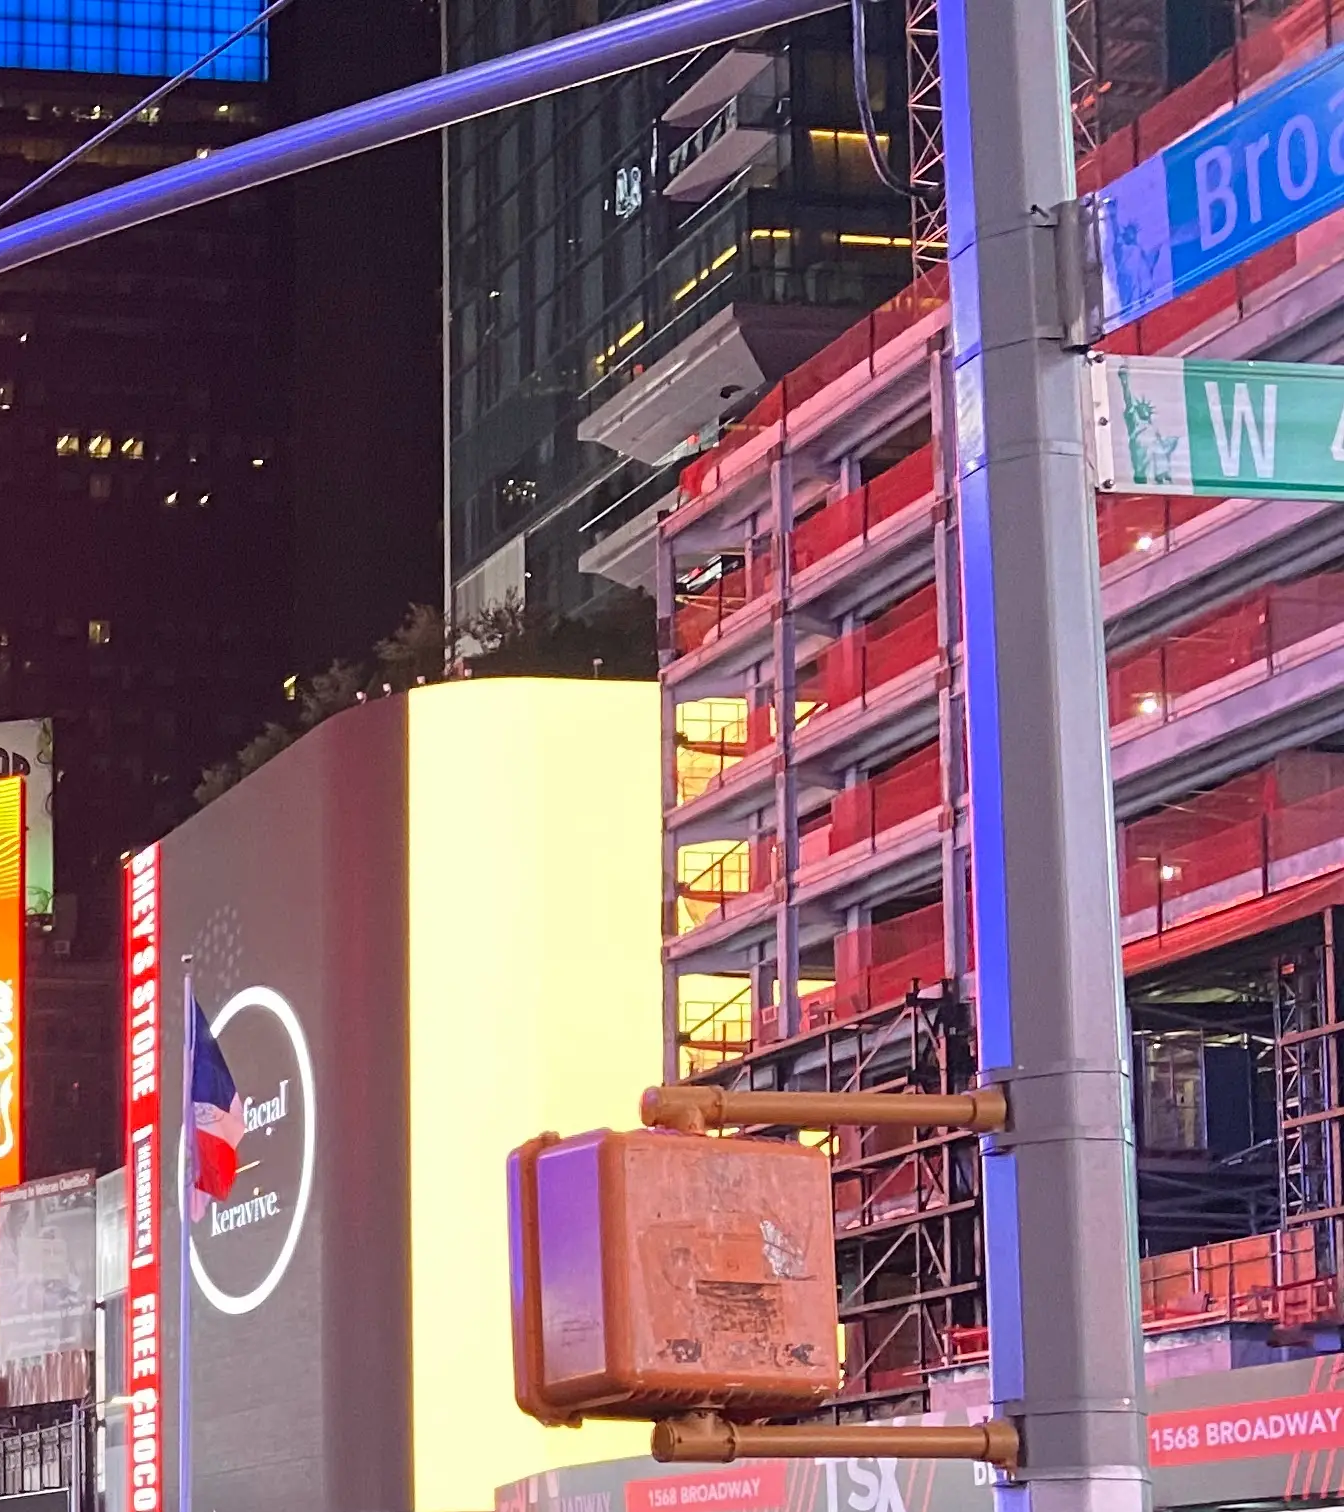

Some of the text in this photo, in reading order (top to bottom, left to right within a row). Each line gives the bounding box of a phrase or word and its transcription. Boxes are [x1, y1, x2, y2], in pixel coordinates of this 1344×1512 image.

[1204, 381, 1278, 479] W
[132, 979, 157, 1101] STORE
[132, 1293, 157, 1380] FREE
[1151, 1407, 1343, 1452] 1568 BROADWAY
[648, 1477, 761, 1508] 1568 BROADWAY
